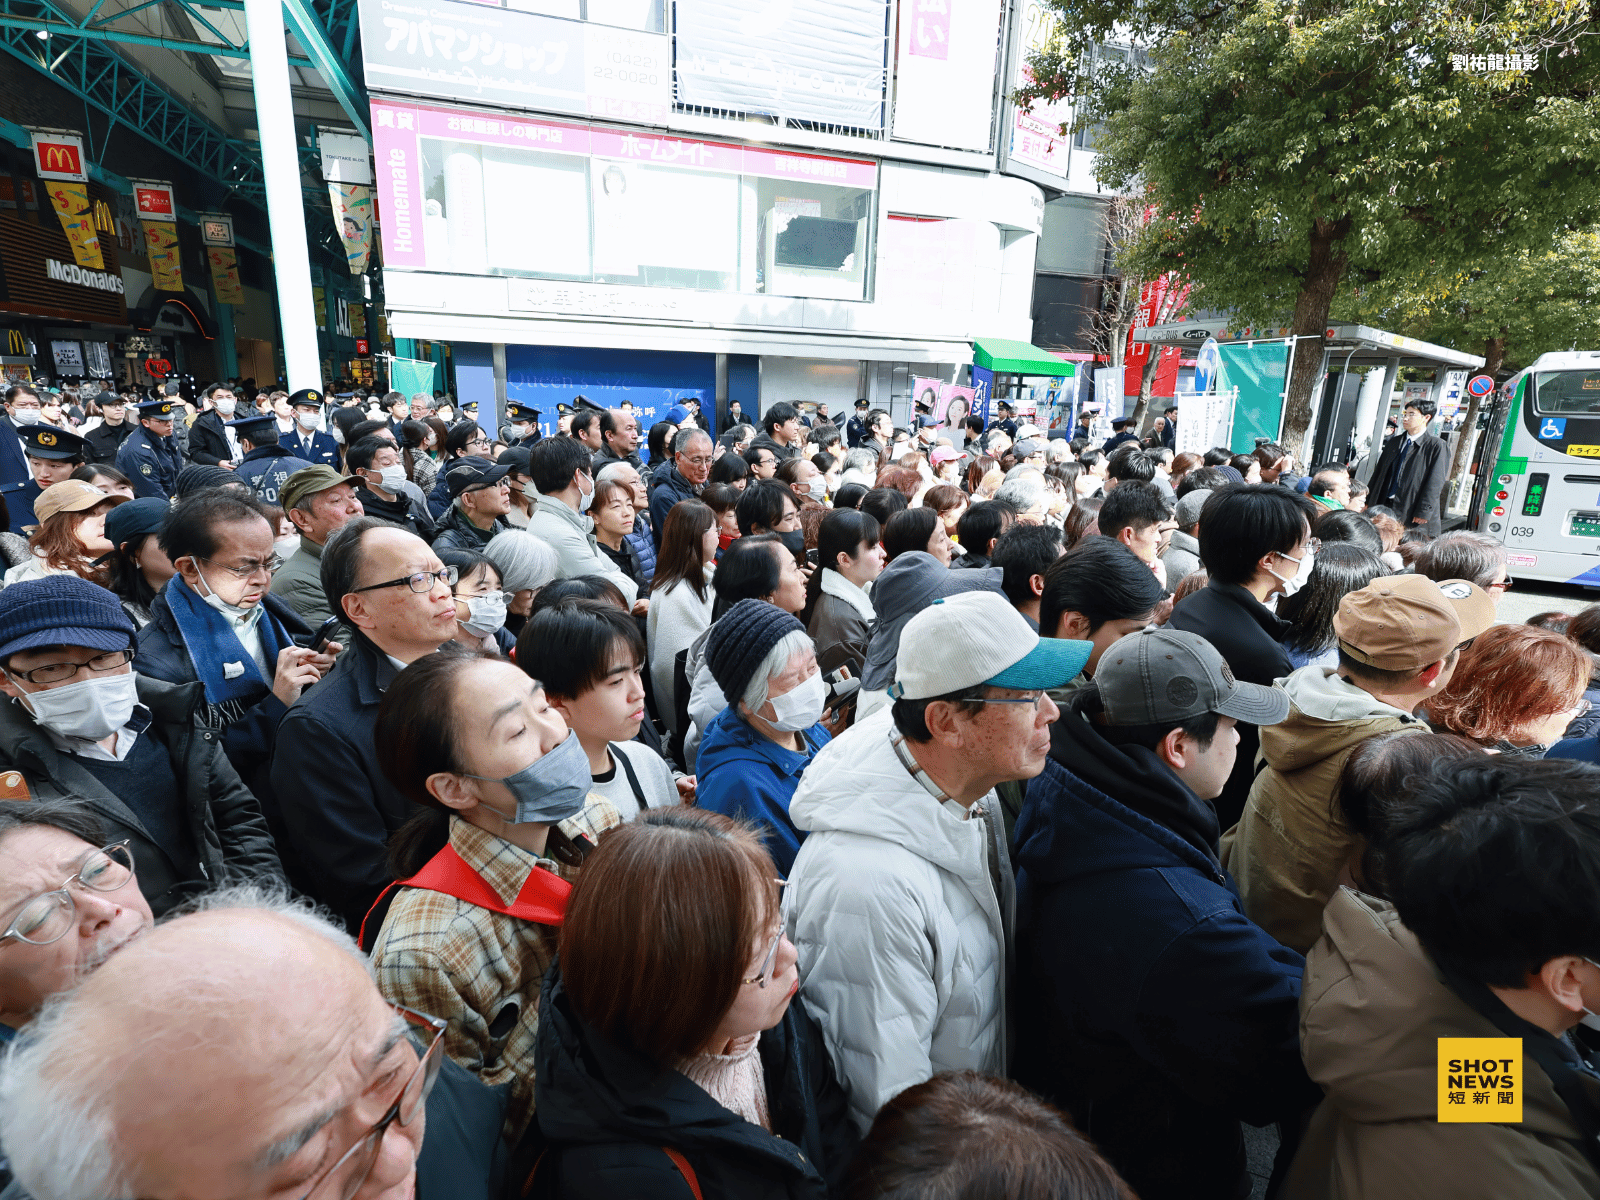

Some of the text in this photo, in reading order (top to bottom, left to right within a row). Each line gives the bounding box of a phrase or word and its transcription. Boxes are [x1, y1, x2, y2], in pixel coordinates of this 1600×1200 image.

[383, 16, 569, 75] アパマンショップ
[606, 50, 658, 70] (0422)
[593, 66, 658, 86] 22-0020
[376, 109, 414, 131] 賃貸
[447, 116, 563, 144] お部屋探しの専門店
[620, 133, 713, 165] ホームメイト
[387, 147, 414, 253] Homemate
[46, 258, 124, 294] McDonald's
[1449, 371, 1467, 381] TAXI
[1511, 526, 1535, 537] 039
